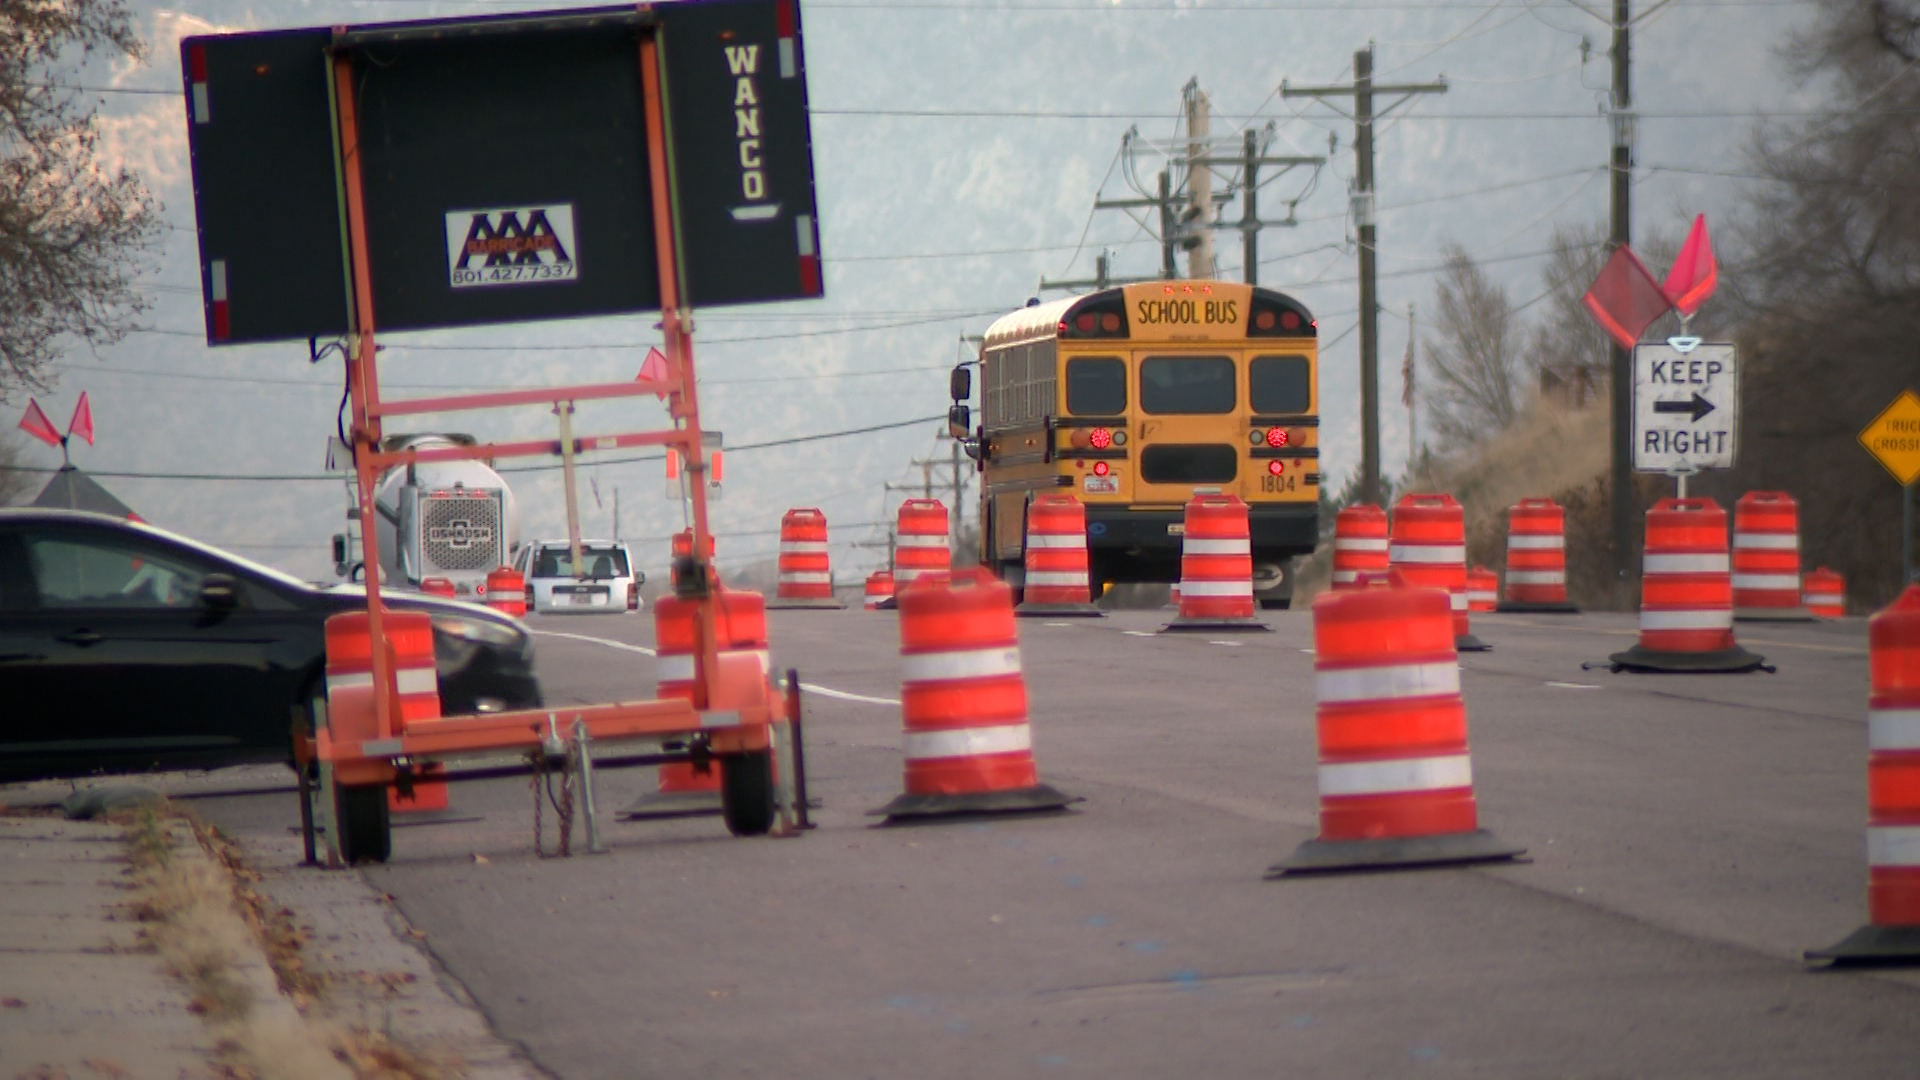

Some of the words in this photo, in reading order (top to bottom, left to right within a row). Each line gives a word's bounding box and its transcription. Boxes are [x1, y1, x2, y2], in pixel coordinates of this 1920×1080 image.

[724, 45, 764, 199] WANCO
[453, 260, 573, 284] 801.427.7337
[1138, 300, 1200, 324] SCHOOL
[1205, 300, 1237, 324] BUS
[1651, 361, 1722, 384] KEEP
[1885, 421, 1920, 433] TRUC
[1644, 430, 1728, 454] RIGHT
[1260, 475, 1294, 492] 1804
